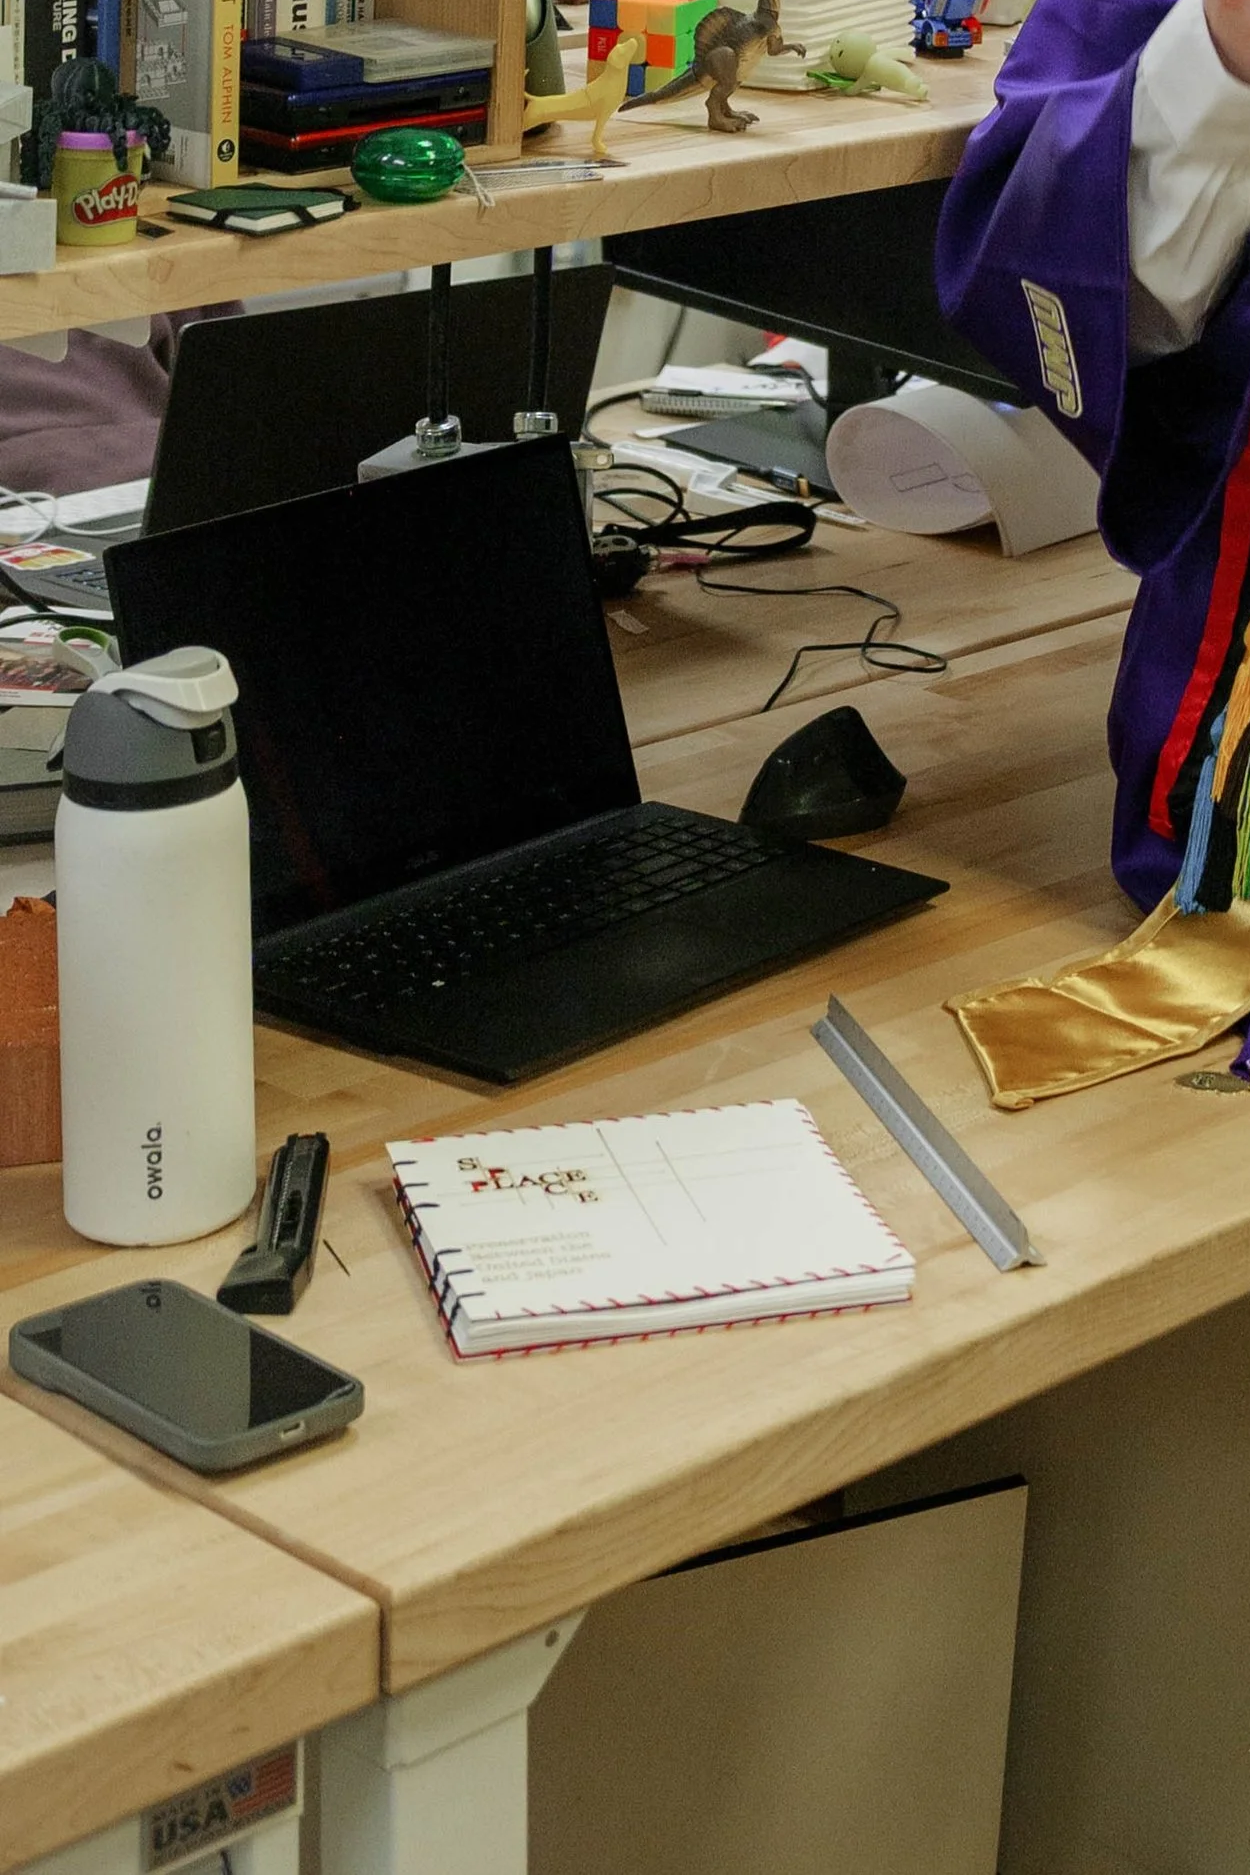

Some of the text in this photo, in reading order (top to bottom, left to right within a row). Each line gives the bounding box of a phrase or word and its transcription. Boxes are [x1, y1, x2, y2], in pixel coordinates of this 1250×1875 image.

[222, 24, 235, 60] TOM
[221, 66, 235, 123] ALPHIN
[141, 1125, 163, 1200] owala
[152, 1798, 229, 1850] USA
